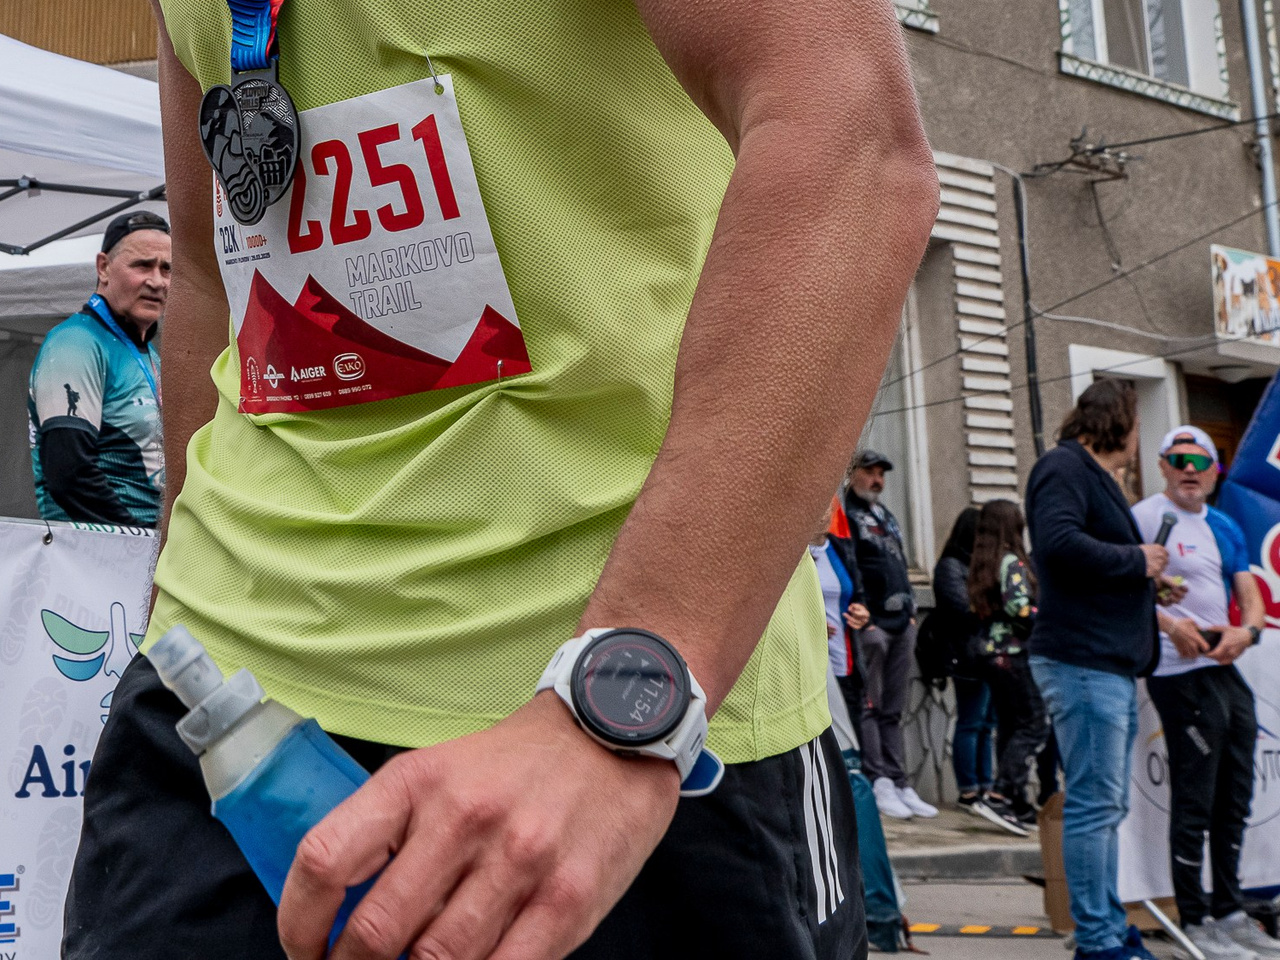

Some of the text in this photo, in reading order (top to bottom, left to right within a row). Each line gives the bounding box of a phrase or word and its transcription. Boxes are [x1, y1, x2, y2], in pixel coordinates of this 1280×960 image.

[287, 113, 461, 255] 2251
[219, 224, 240, 254] 22K
[345, 231, 475, 288] MARKOVO
[349, 280, 422, 320] TRAIL
[629, 678, 664, 723] 11:54
